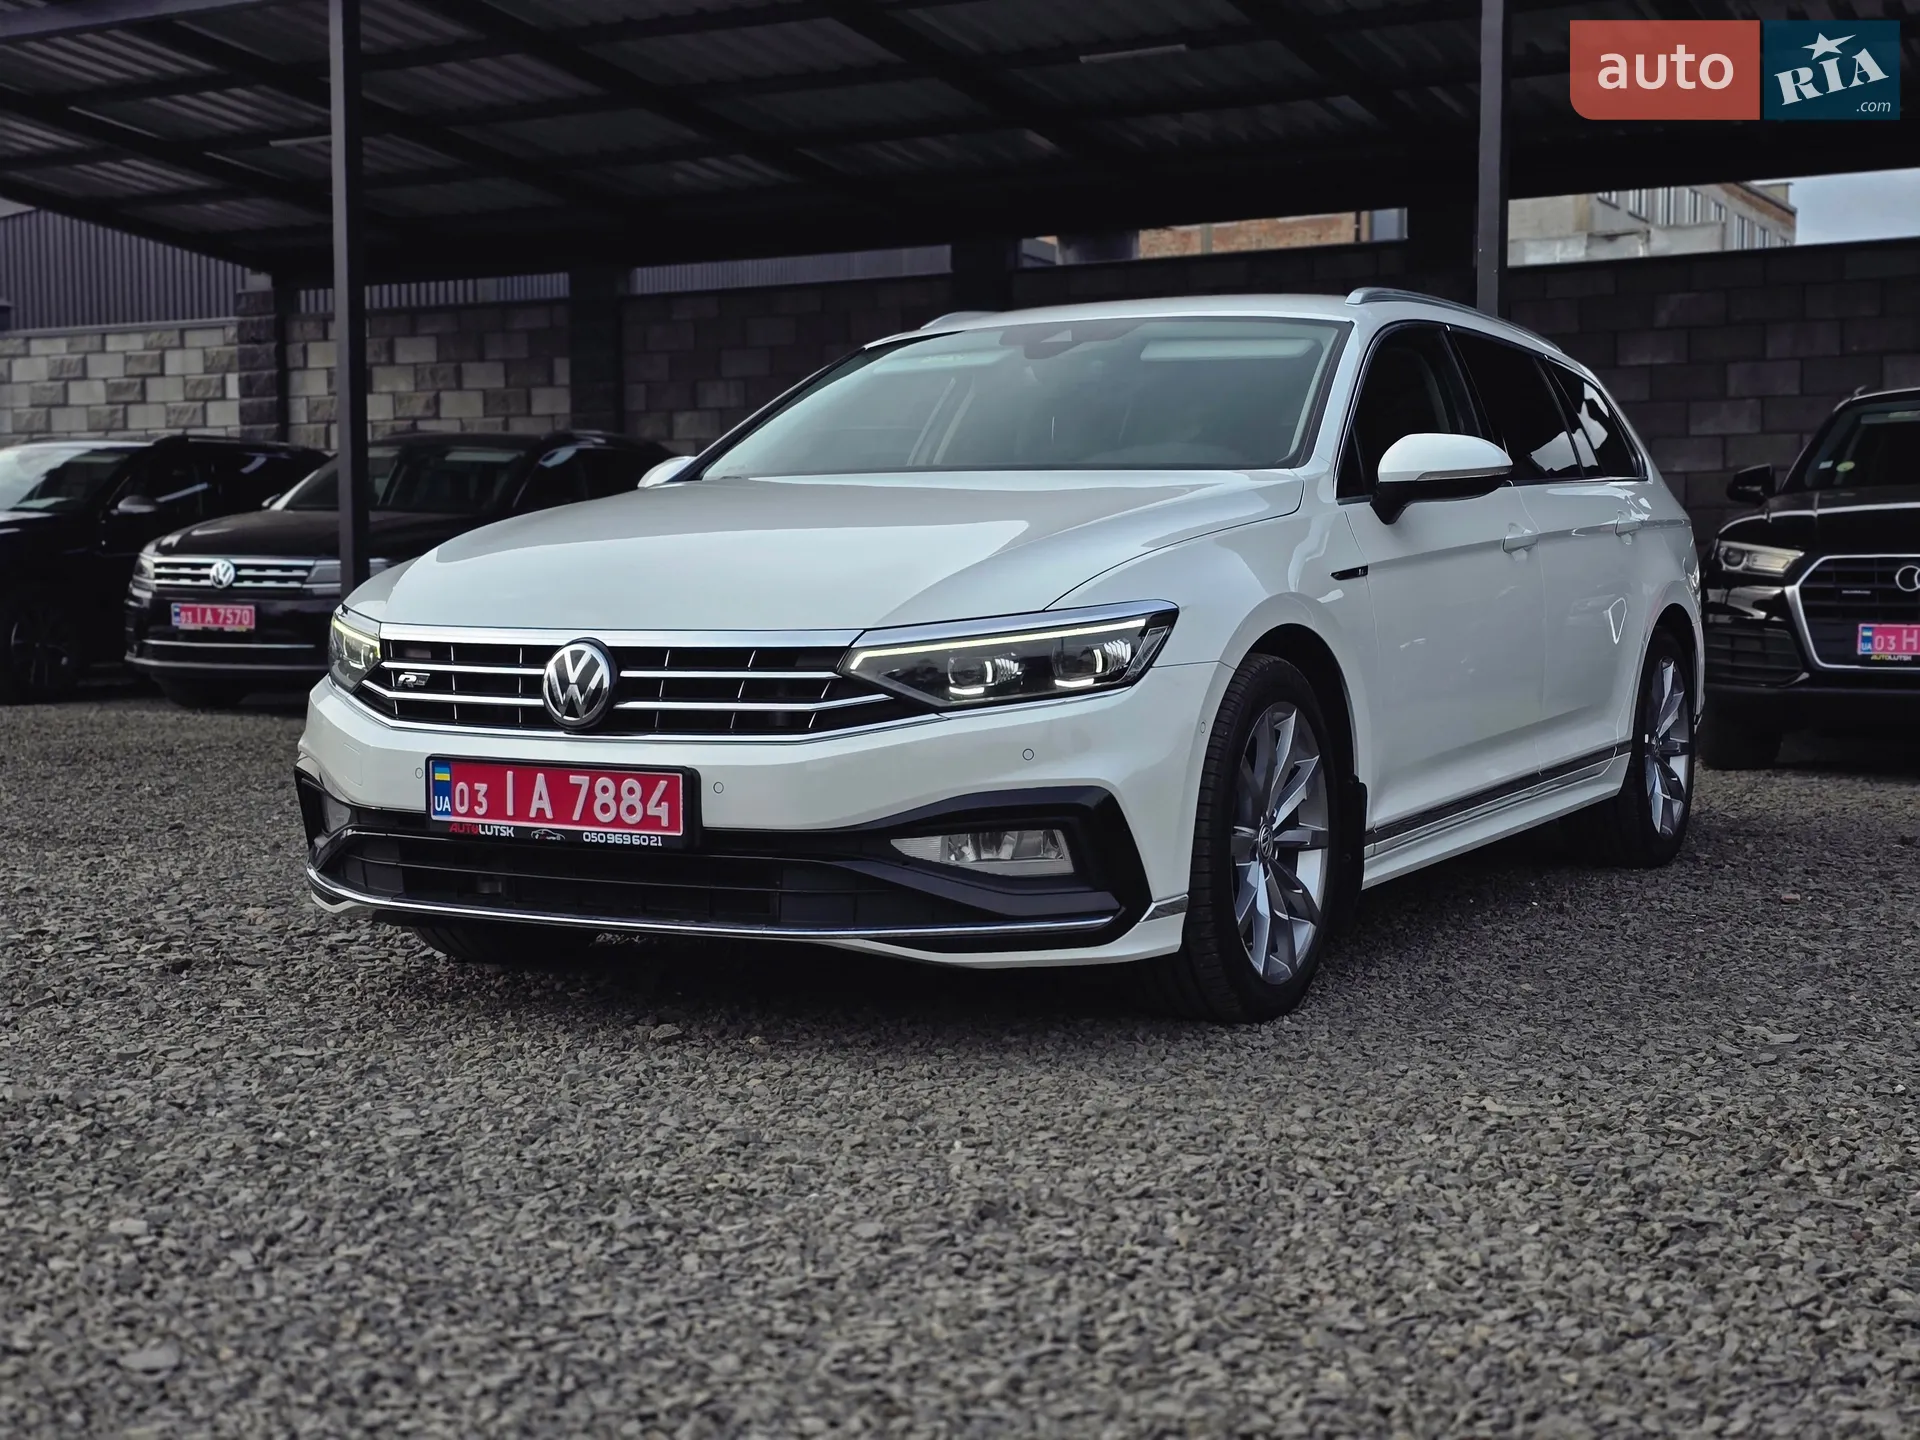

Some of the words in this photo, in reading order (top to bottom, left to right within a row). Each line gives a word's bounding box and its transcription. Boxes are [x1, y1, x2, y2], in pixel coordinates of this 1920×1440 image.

[217, 608, 250, 626] 7570
[1875, 635, 1896, 651] 03
[434, 796, 451, 812] UA
[455, 782, 488, 816] 03
[569, 775, 669, 827] 7884
